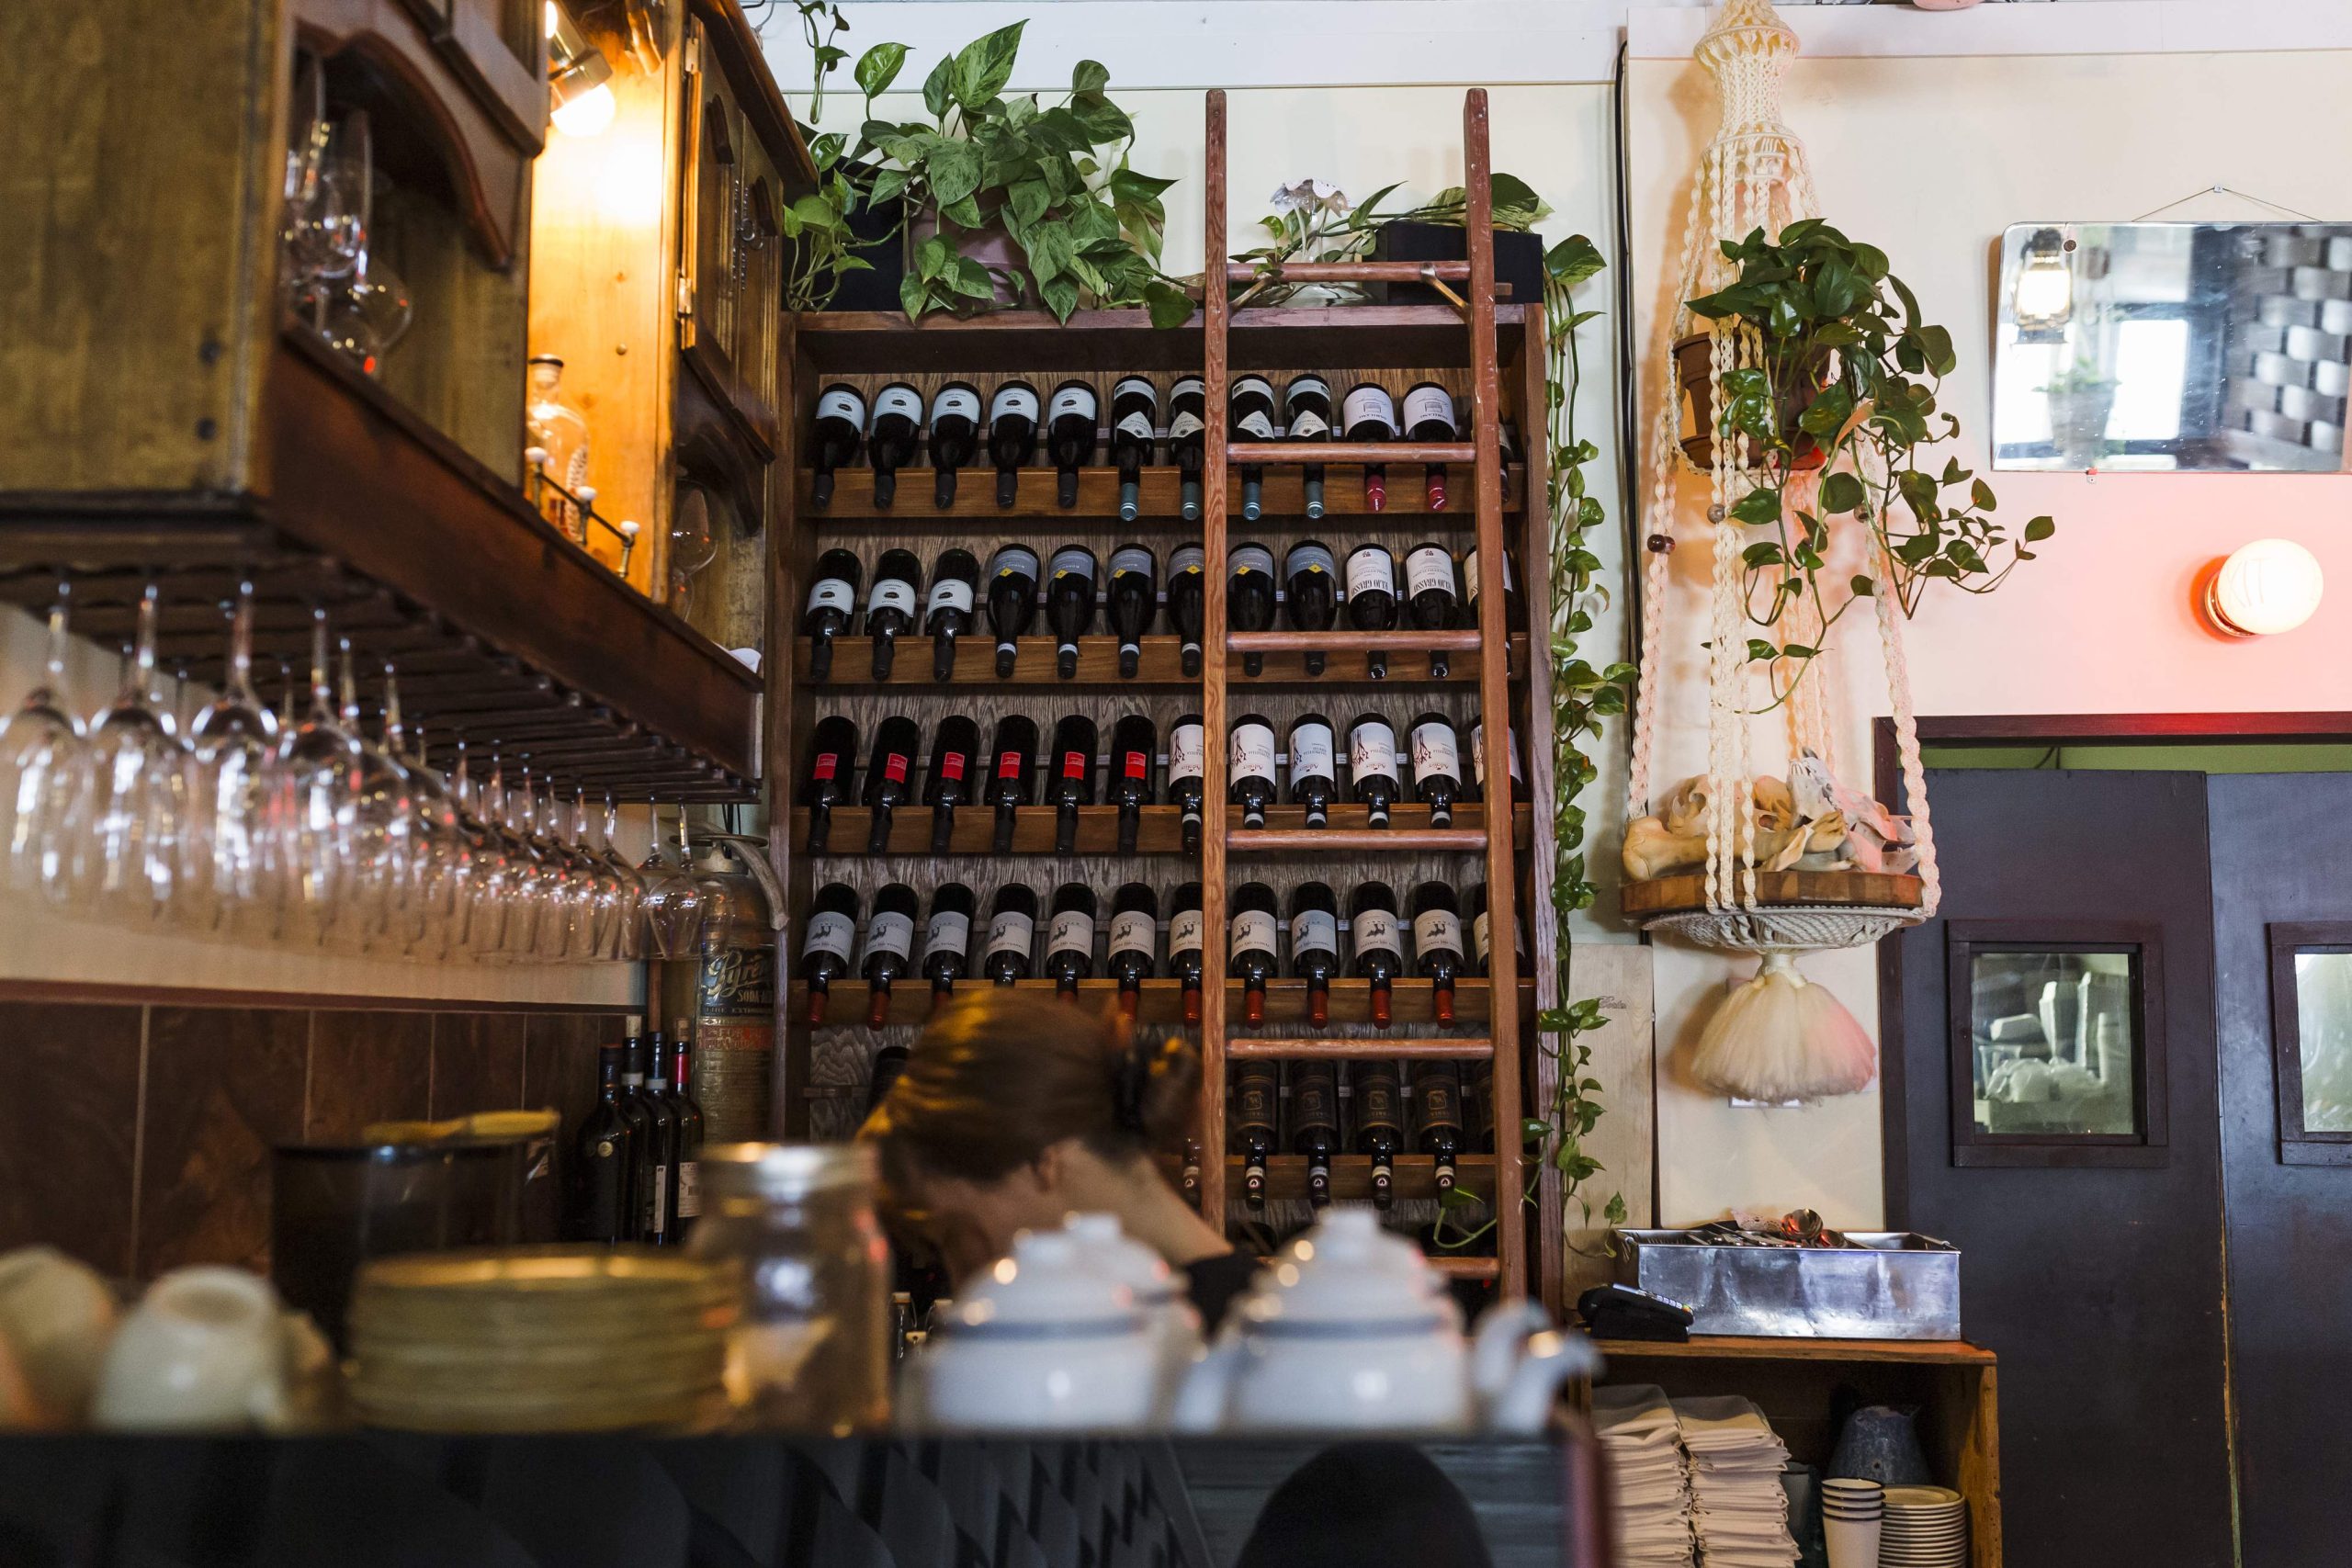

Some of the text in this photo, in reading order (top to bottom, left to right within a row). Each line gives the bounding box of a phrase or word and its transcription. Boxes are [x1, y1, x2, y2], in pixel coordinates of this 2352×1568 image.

[1351, 579, 1389, 597] ELIO GRASSO
[1413, 579, 1437, 593] GRASSO
